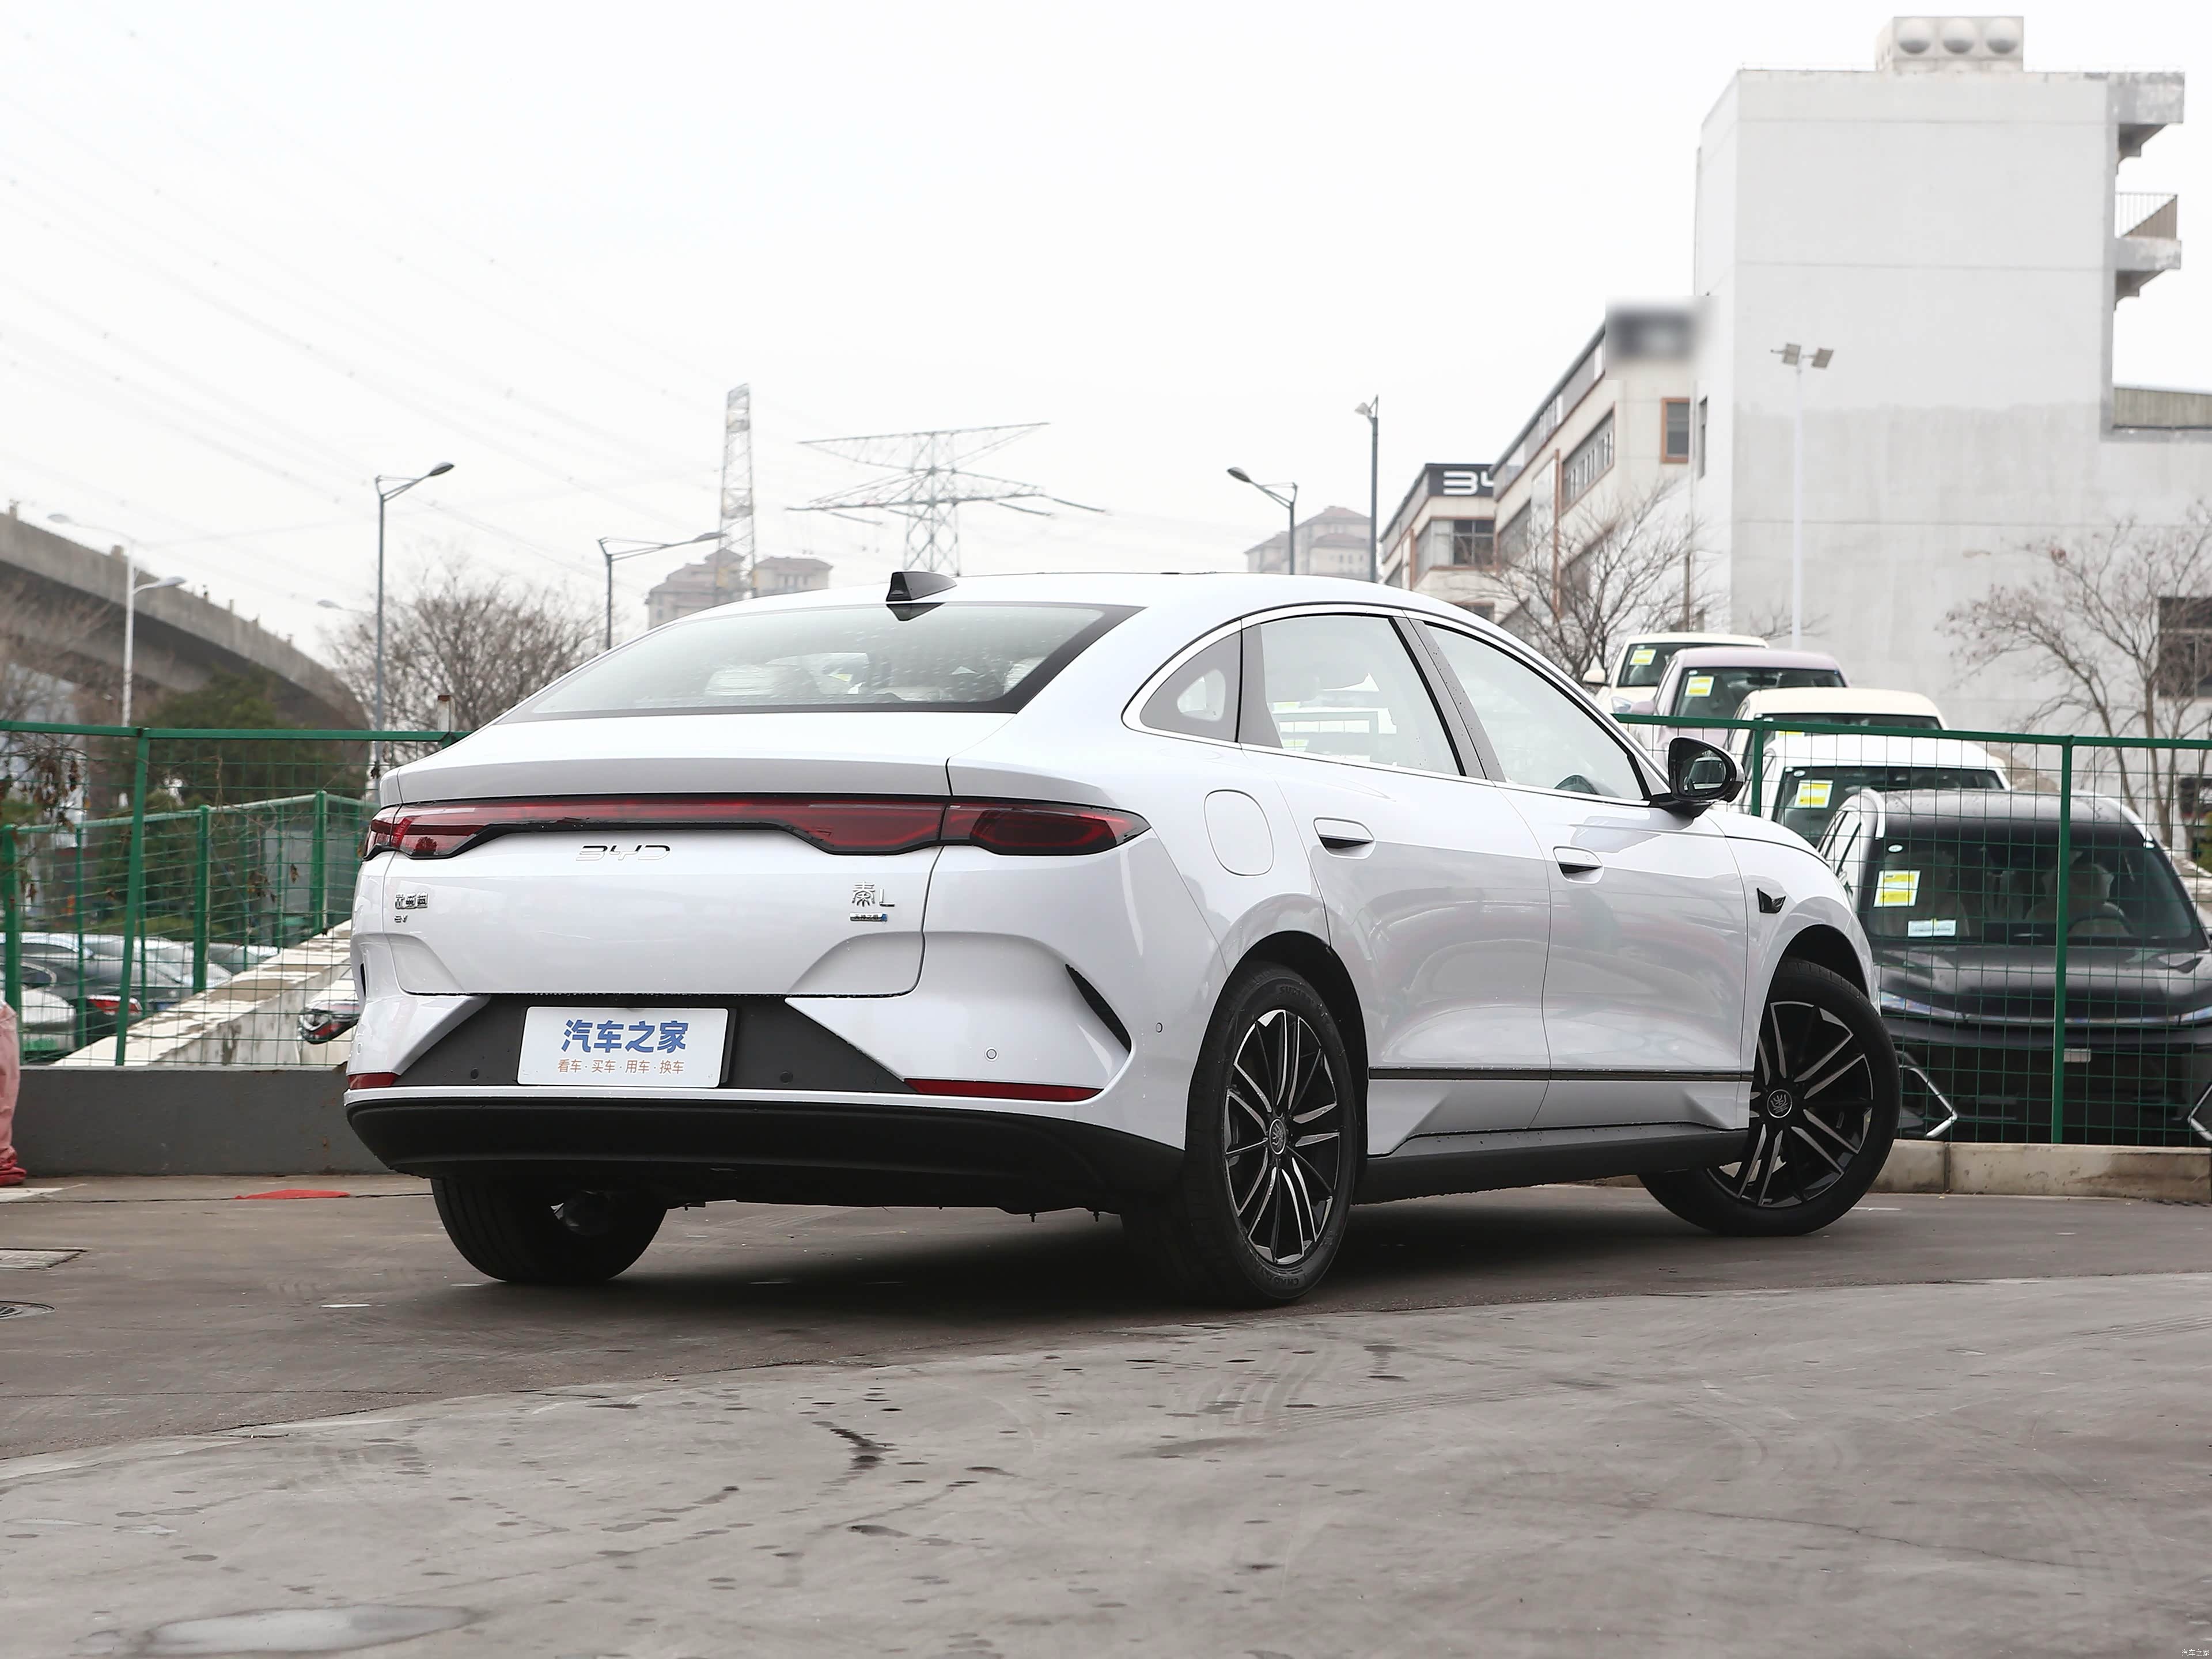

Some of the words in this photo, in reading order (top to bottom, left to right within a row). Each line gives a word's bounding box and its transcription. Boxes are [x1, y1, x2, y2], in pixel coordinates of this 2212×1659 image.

[576, 844, 671, 861] BYD
[560, 1019, 689, 1054] 汽车之家
